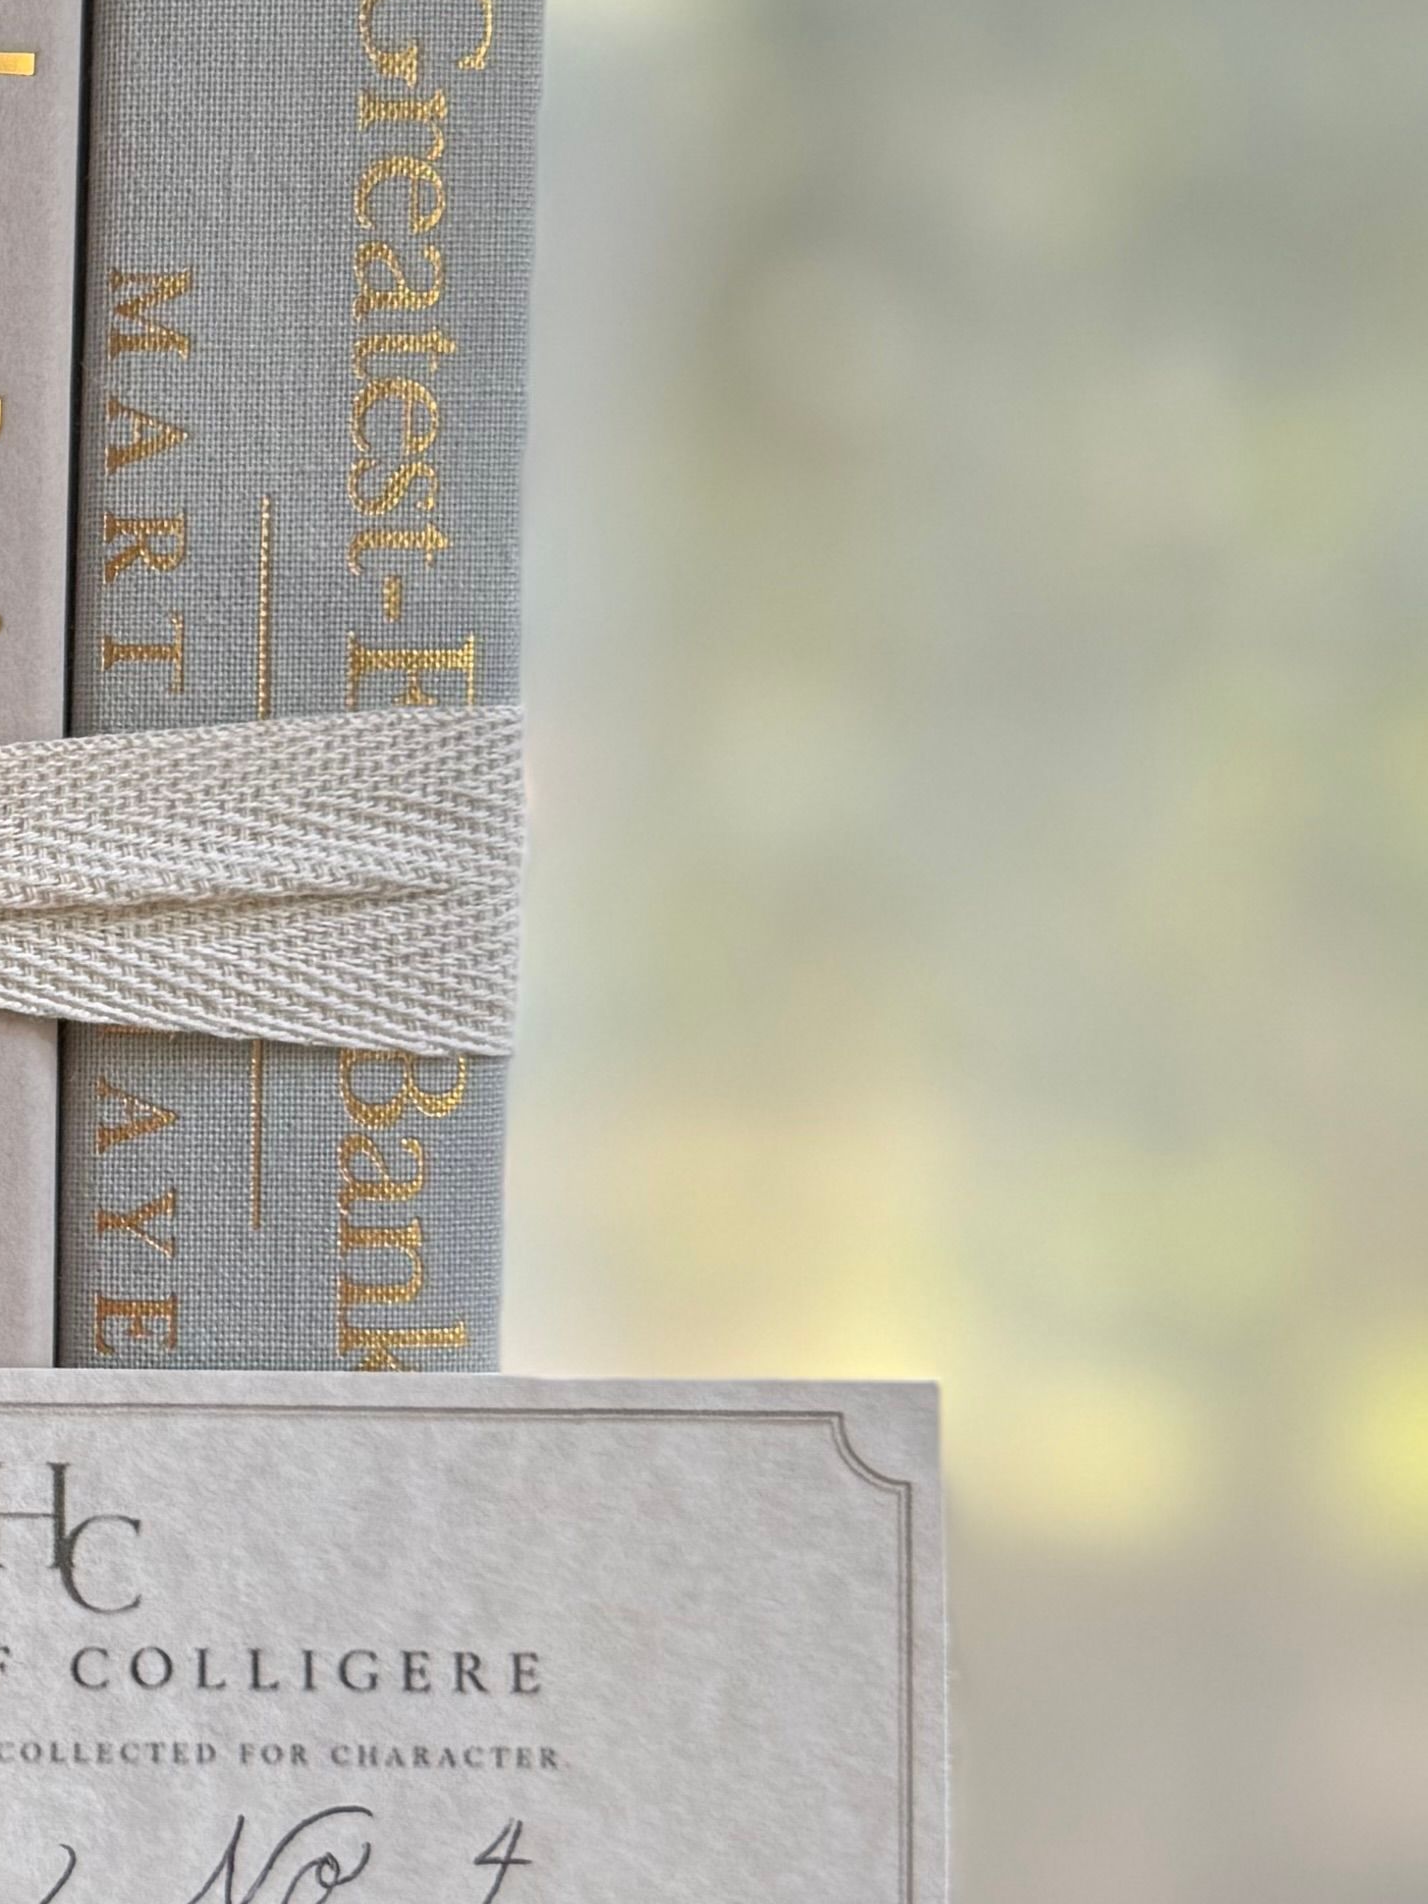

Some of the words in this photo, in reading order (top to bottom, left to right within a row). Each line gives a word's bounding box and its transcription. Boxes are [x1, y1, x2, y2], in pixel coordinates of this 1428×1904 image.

[100, 269, 192, 694] MART
[92, 1026, 179, 1356] AYE
[70, 1646, 542, 1695] COLLIGERE
[240, 1744, 307, 1765] FOR
